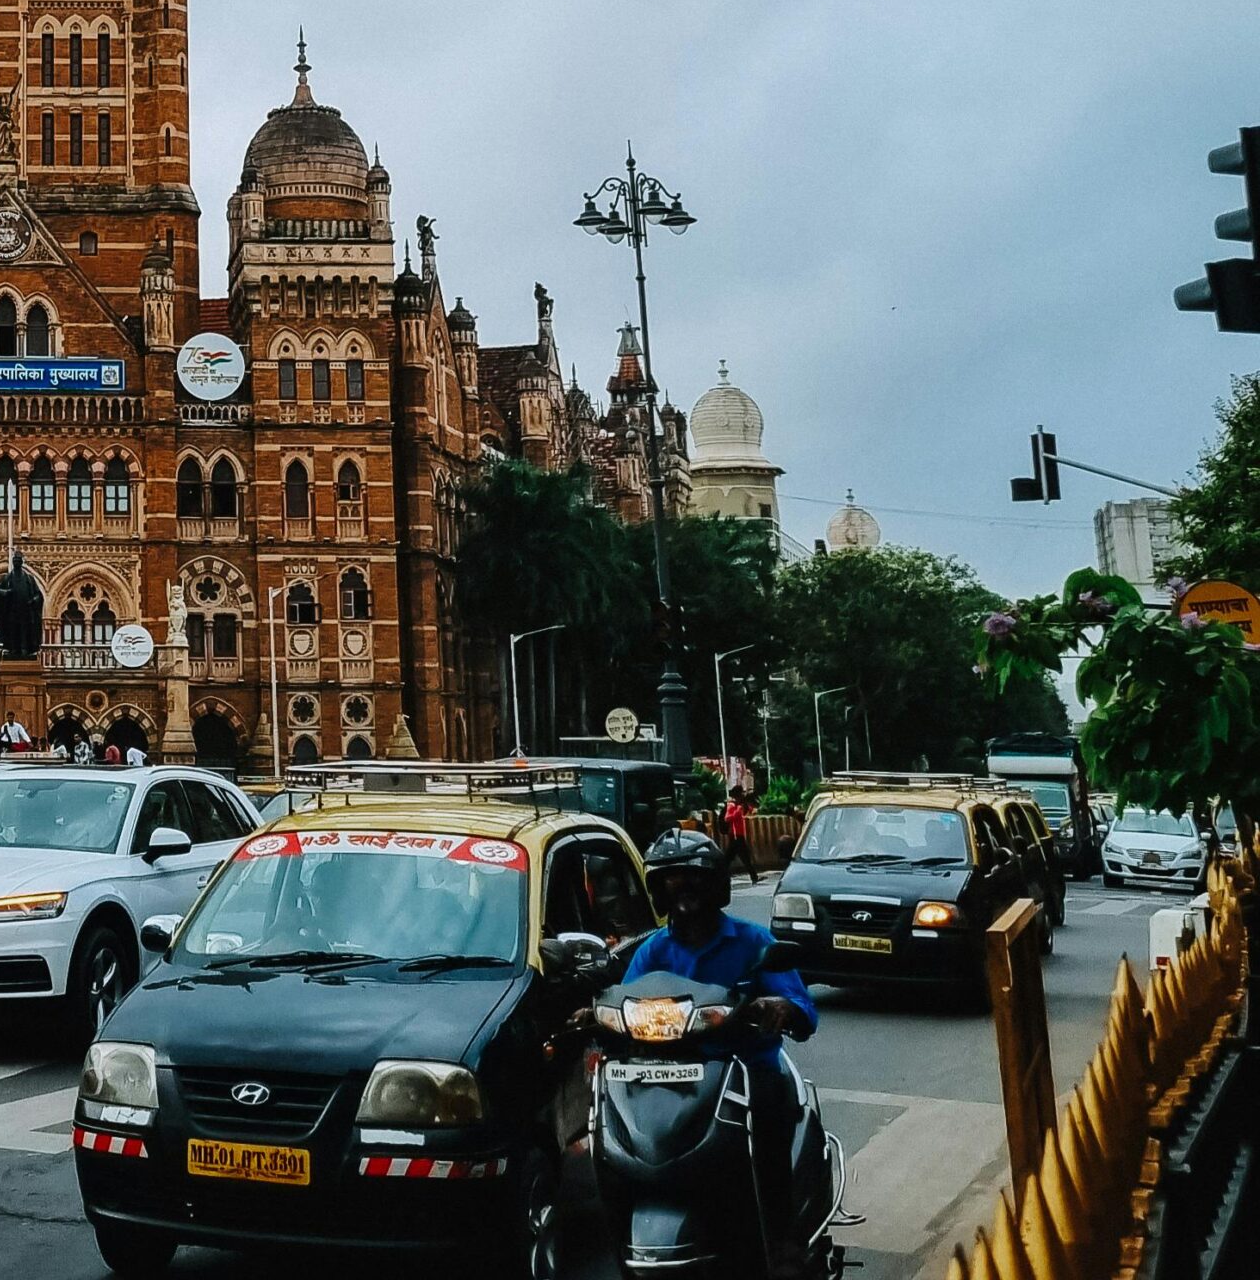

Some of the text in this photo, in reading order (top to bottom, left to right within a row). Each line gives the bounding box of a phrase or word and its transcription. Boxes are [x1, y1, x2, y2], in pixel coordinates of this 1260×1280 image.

[49, 368, 98, 385] मुख्यालय
[1187, 597, 1250, 616] पाण्याचा
[611, 1068, 626, 1079] MH
[654, 1069, 670, 1080] CW
[675, 1067, 699, 1079] 3269
